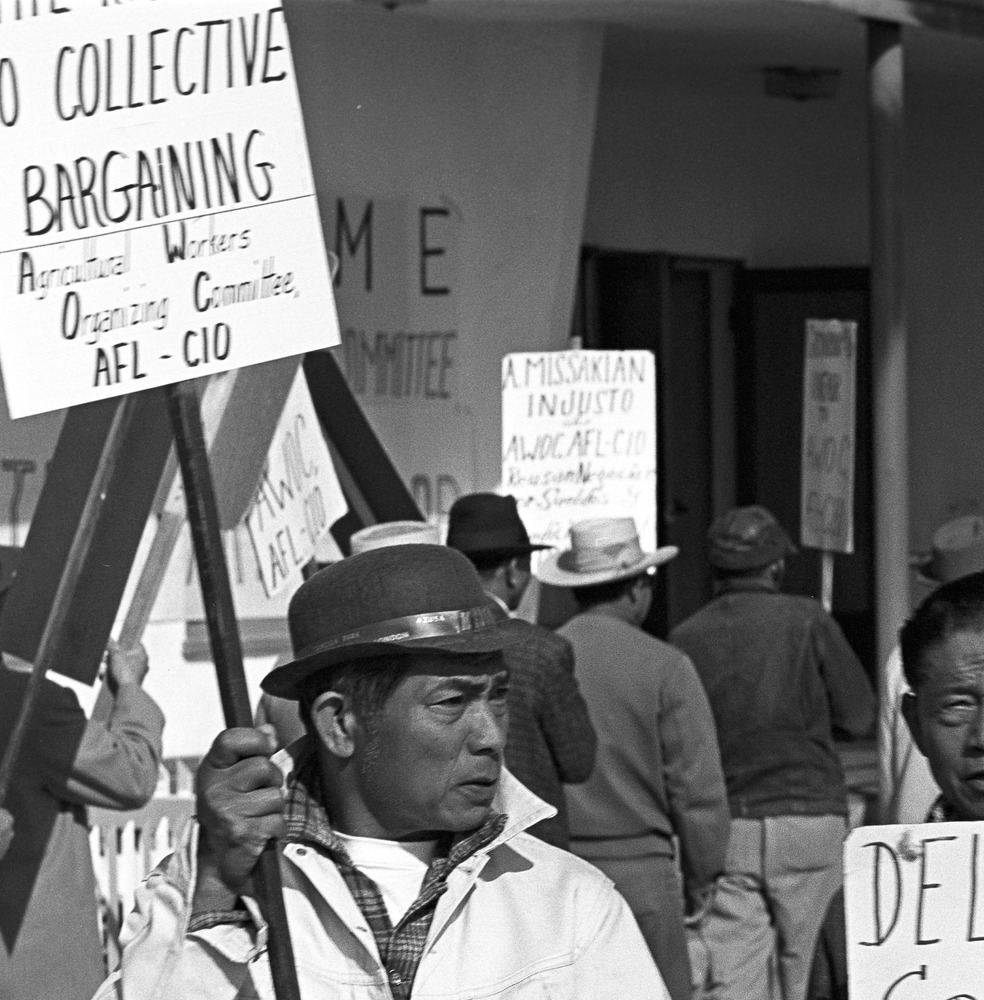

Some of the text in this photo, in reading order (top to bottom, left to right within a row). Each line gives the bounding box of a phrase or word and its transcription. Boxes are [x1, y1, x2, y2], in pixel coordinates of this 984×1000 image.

[55, 7, 287, 121] COLLECTIVE
[23, 129, 276, 237] BARGAINING
[17, 220, 251, 300] Agricultural Workers
[62, 288, 169, 345] Organizing
[528, 388, 634, 418] INJUSTO
